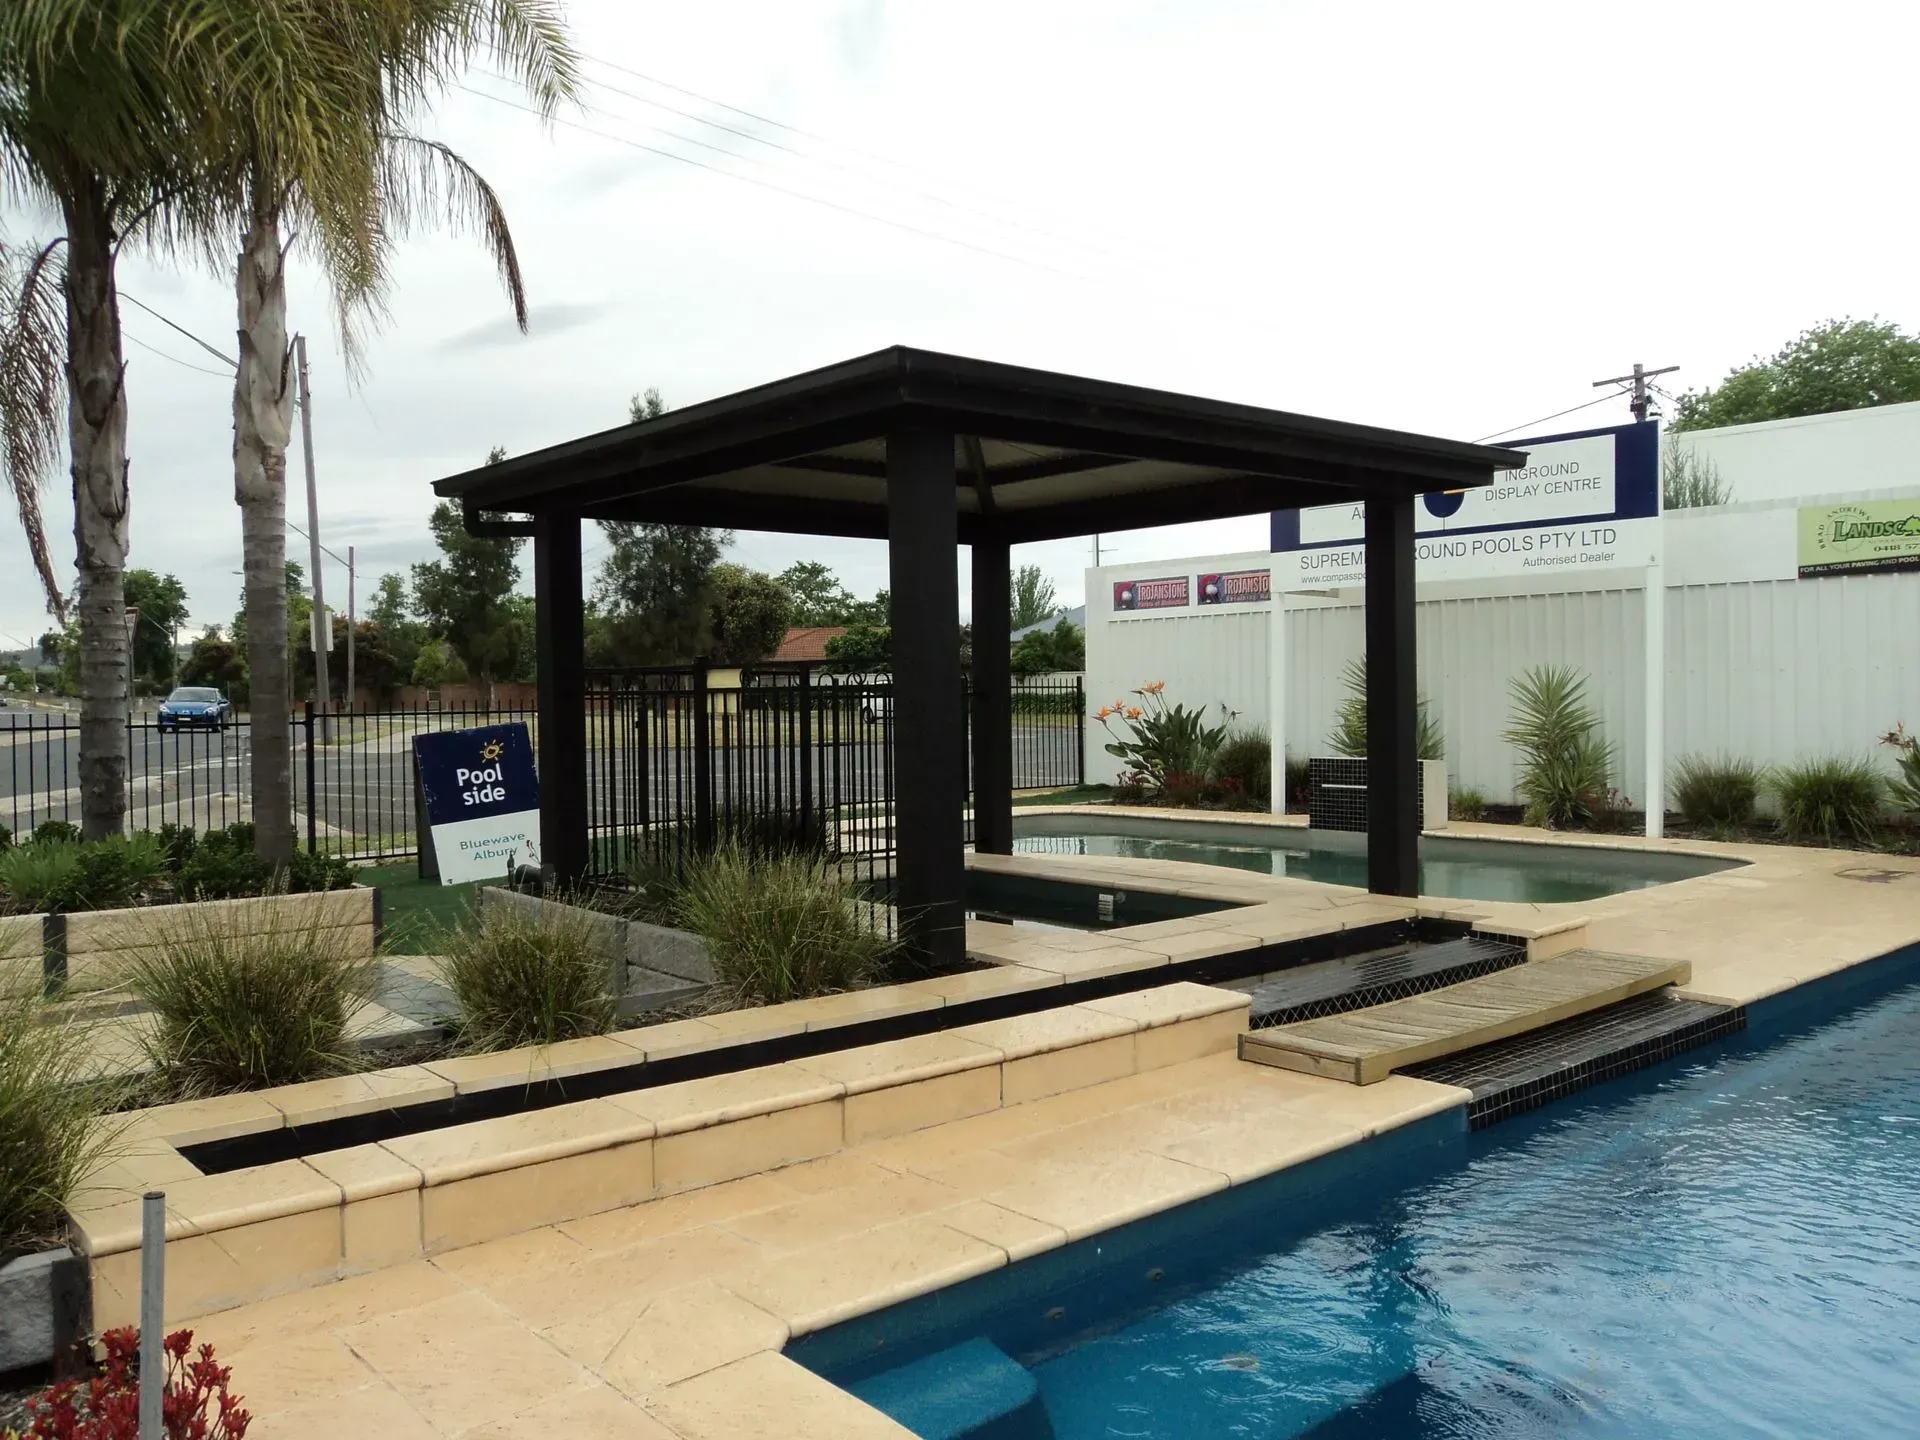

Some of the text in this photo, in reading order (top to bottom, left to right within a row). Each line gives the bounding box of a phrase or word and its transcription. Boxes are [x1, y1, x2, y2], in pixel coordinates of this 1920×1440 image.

[1505, 461, 1580, 482] INGROUND
[1485, 477, 1602, 502] DISPLAY CENTRE
[1300, 528, 1617, 570] SUPREM OUND POOLS PTY LTD
[1522, 551, 1616, 568] Authorised Dealer
[1830, 562, 1850, 570] YOUR
[1852, 560, 1879, 568] PAVING
[1881, 558, 1897, 566] AND
[456, 763, 503, 786] Pool
[462, 784, 506, 806] side
[460, 833, 525, 850] Bluewave
[473, 847, 518, 861] Albury
